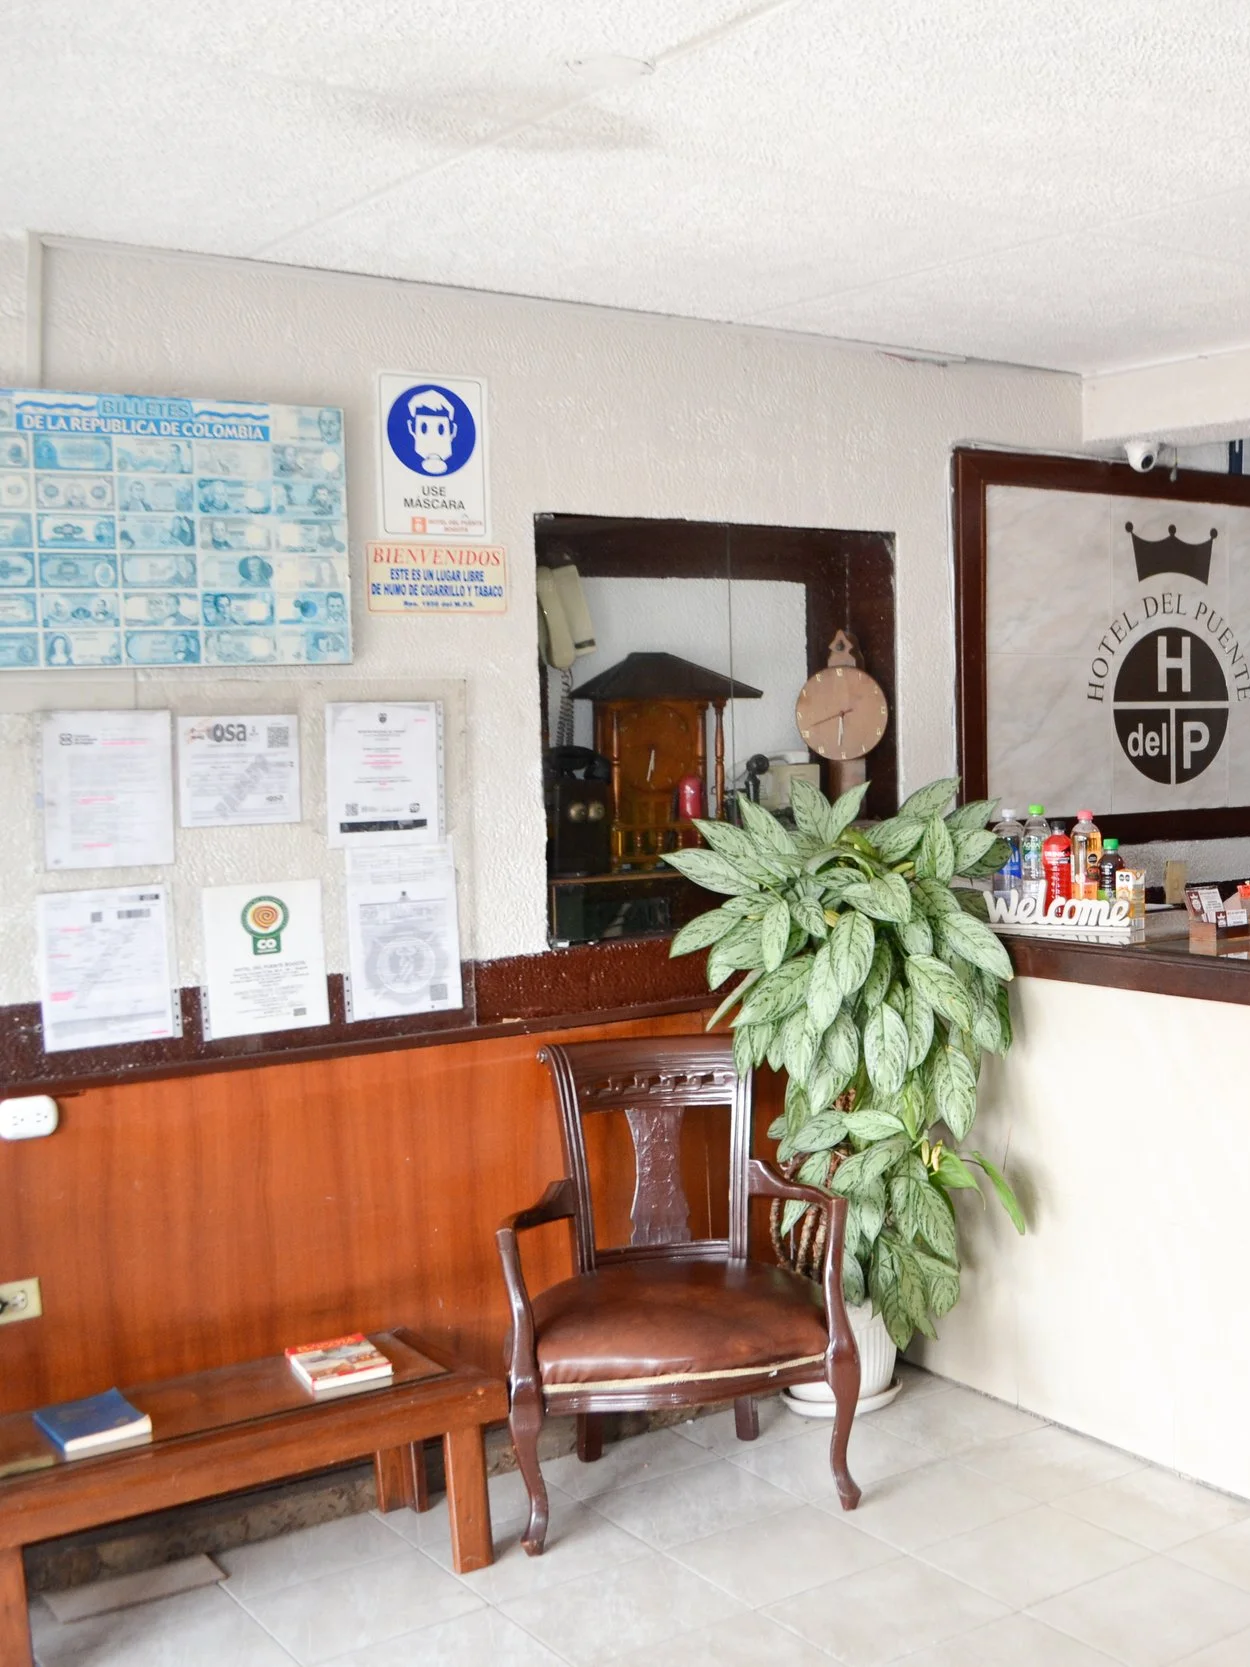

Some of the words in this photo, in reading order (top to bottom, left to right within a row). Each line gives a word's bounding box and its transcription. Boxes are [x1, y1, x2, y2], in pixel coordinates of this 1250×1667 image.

[101, 400, 190, 419] BILLETES
[23, 414, 44, 429] DE
[47, 416, 69, 431] LA
[70, 417, 157, 435] REPUBLICA
[160, 421, 181, 437] DE
[182, 423, 264, 440] COLOMBIA
[421, 486, 447, 497] USE
[403, 496, 466, 510] MÁSCARA
[373, 547, 501, 566] BIENVENIDOS
[390, 568, 409, 580] ESTE
[412, 568, 421, 581] ES
[423, 569, 434, 581] UN
[436, 570, 461, 582] LUGAR
[463, 570, 485, 582] LIBRE
[371, 583, 381, 595] DE
[384, 583, 407, 596] HUMO
[409, 584, 418, 596] DE
[421, 584, 466, 597] CIGARRILLO
[467, 585, 472, 597] Y
[474, 585, 503, 598] TABACO
[1086, 612, 1139, 703] HOTEL
[1142, 592, 1188, 620] DEL
[1157, 636, 1192, 693] H
[213, 723, 247, 742] osa
[1127, 722, 1168, 757] del
[1183, 721, 1210, 769] P
